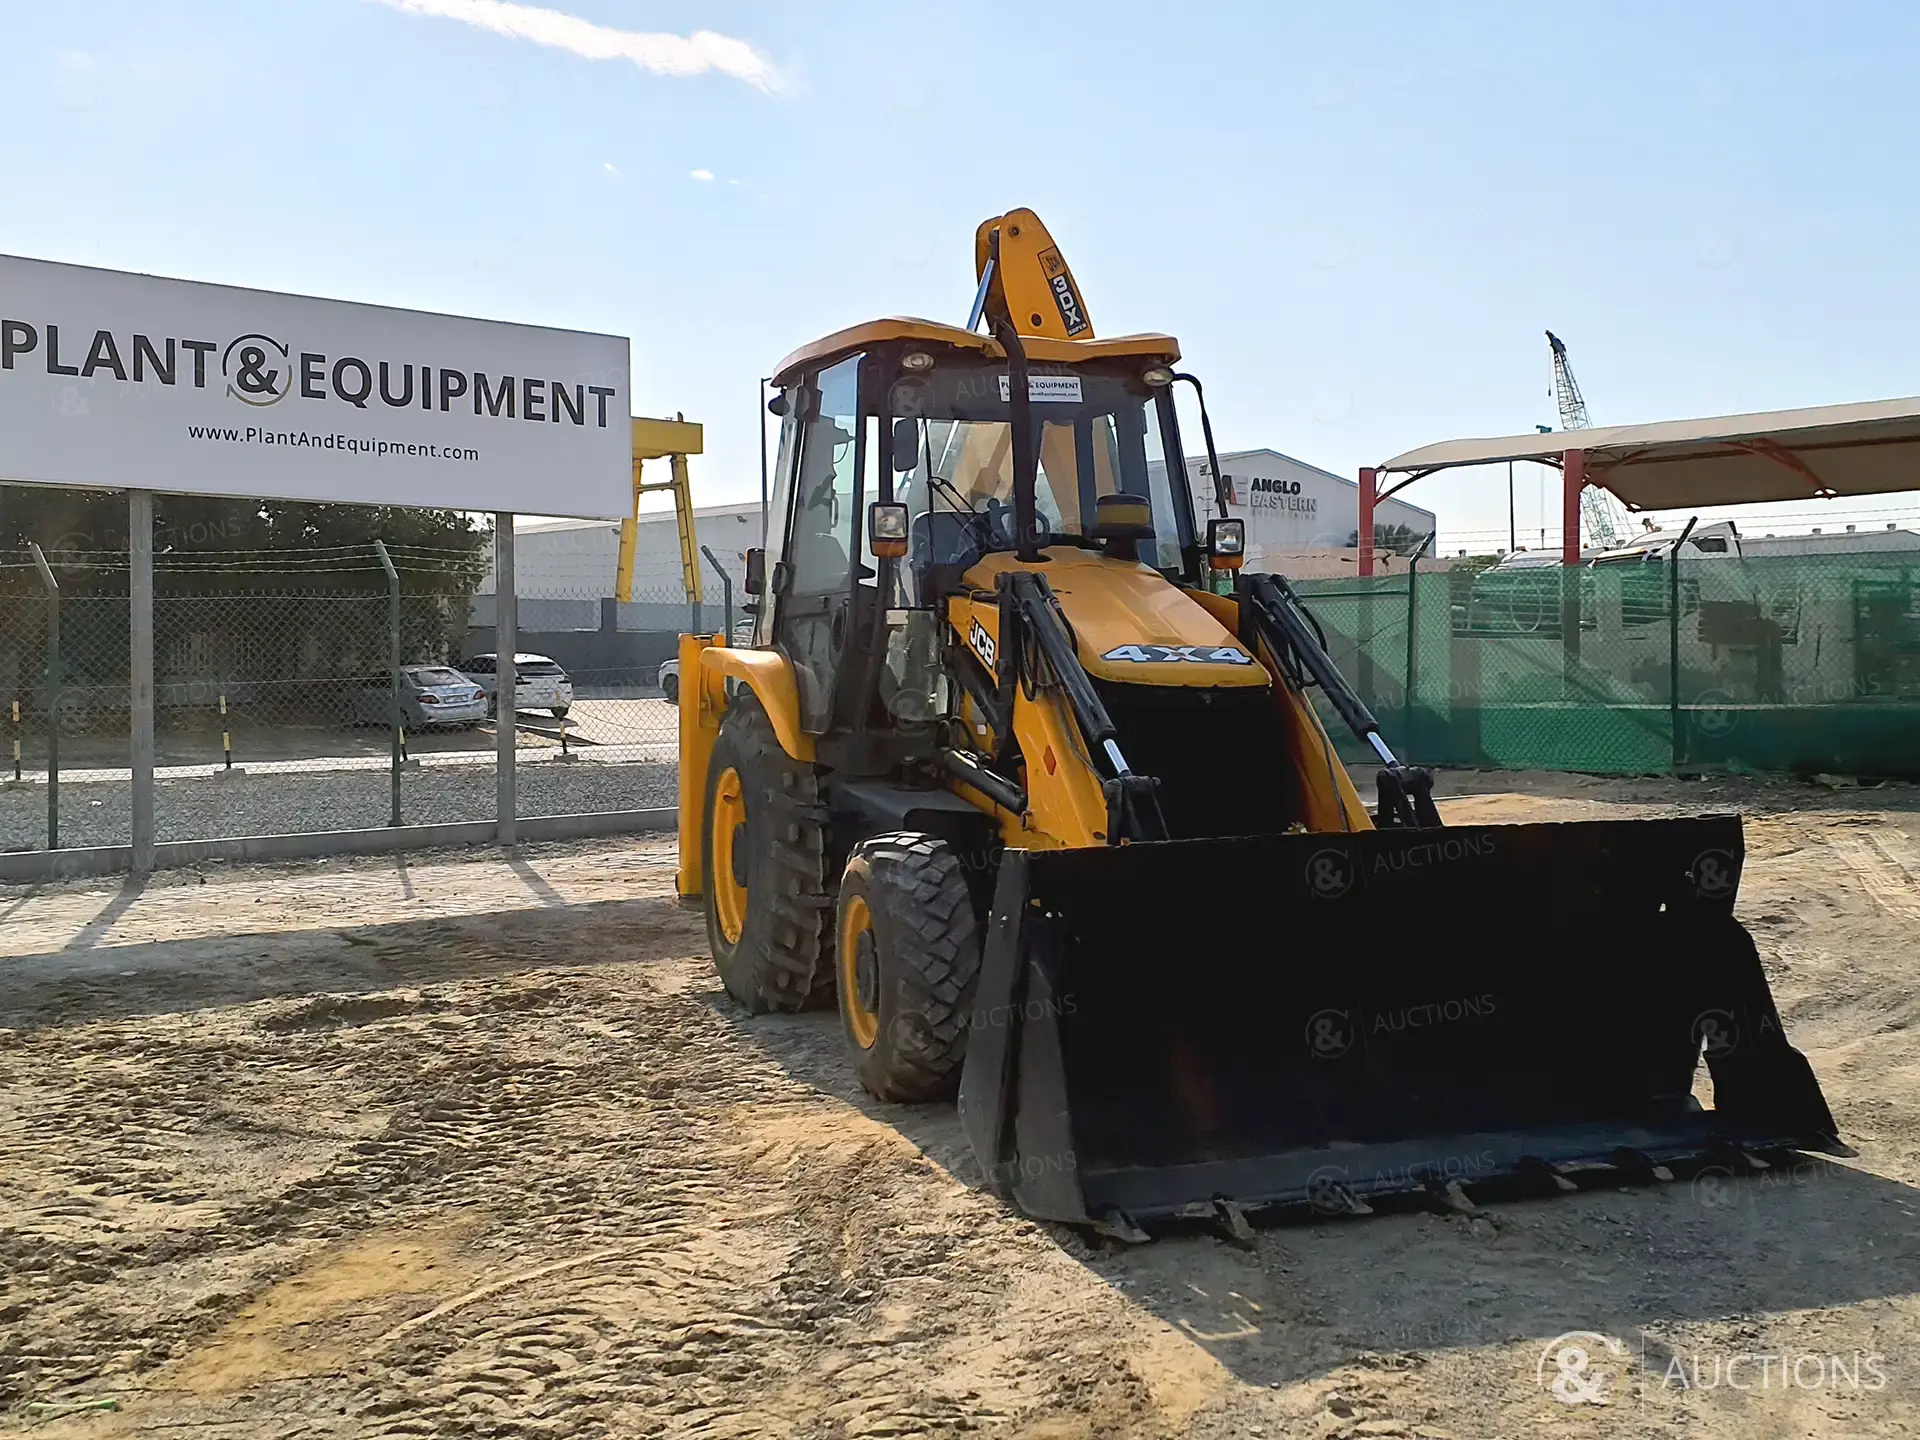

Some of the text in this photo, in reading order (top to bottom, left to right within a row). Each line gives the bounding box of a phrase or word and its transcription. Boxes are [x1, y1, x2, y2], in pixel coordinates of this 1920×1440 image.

[1053, 275, 1081, 326] 3DX
[1, 320, 217, 388] PLANT
[301, 353, 615, 428] EQUIPMENT
[1035, 381, 1079, 389] EQUIPMENT
[188, 426, 479, 461] www.PlantAndEquipment.com
[1250, 493, 1317, 513] EASTERN
[1251, 477, 1301, 496] ANGLO
[970, 622, 995, 667] JCB
